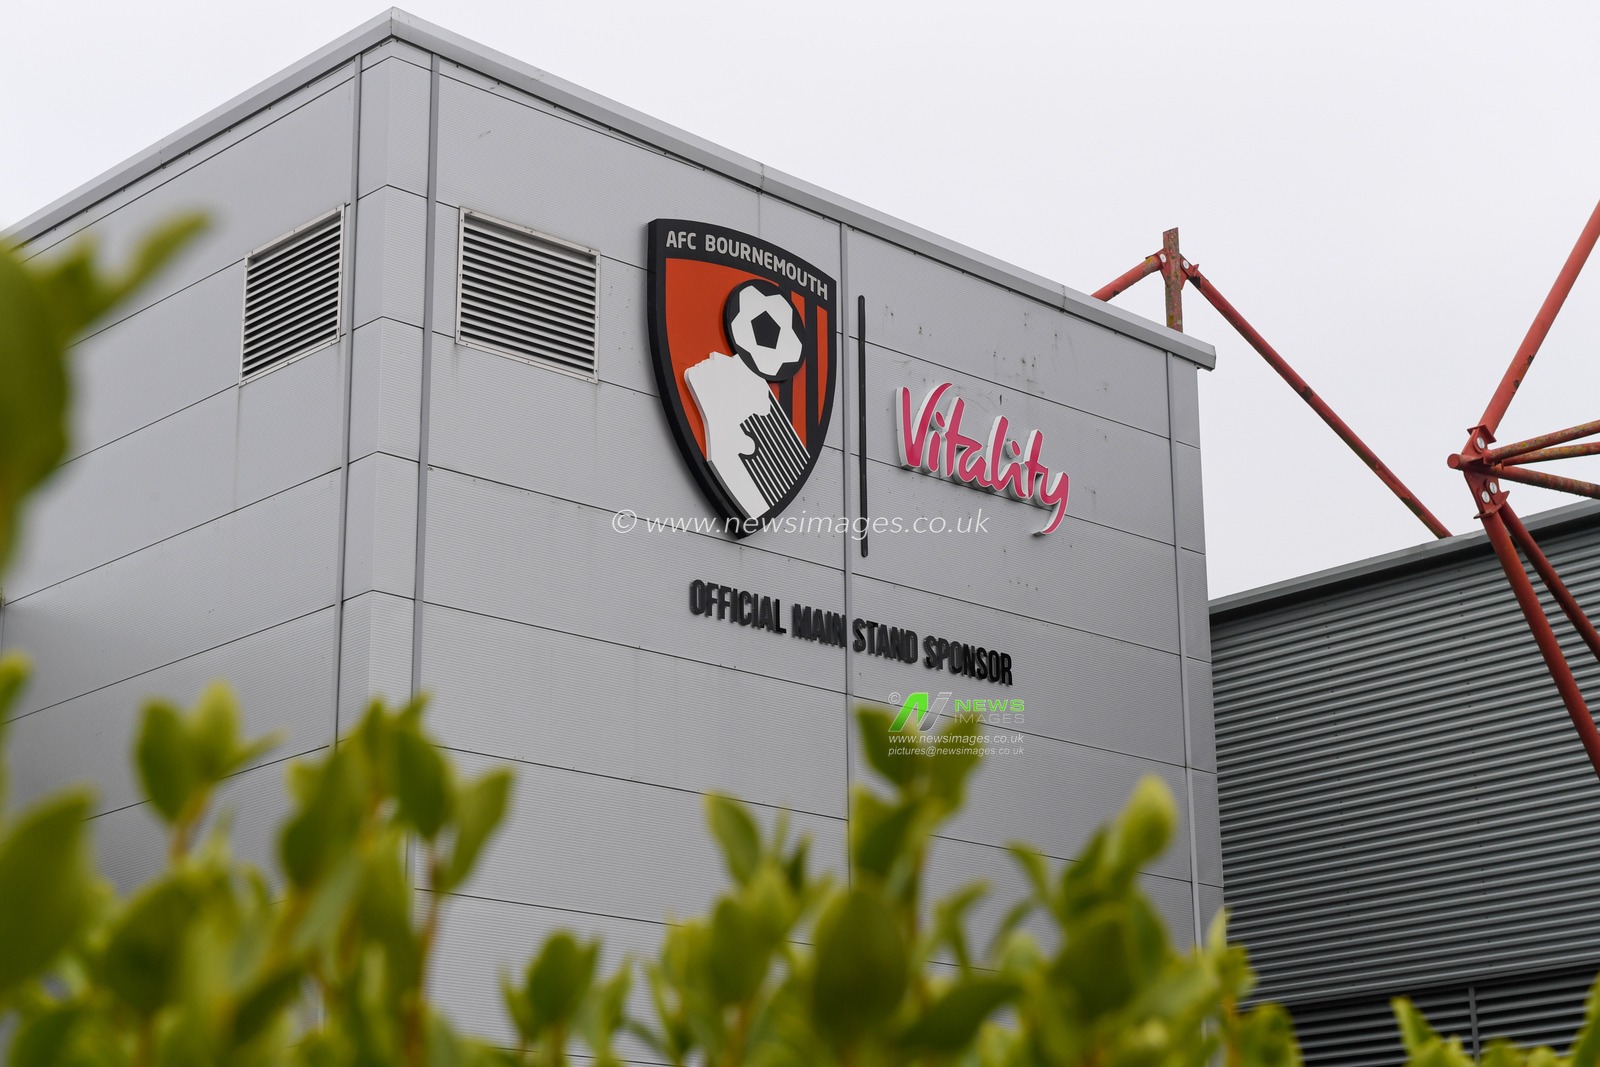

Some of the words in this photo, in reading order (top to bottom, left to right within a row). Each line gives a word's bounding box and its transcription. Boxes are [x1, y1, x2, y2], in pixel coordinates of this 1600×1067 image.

[665, 230, 697, 250] AFC
[705, 234, 828, 301] BOURNEMOUTH
[896, 382, 1070, 536] Vitality
[689, 579, 787, 634] OFFICIAL
[791, 603, 847, 648] MAIN
[852, 617, 919, 664] STAND
[923, 635, 1014, 686] SPONSOR
